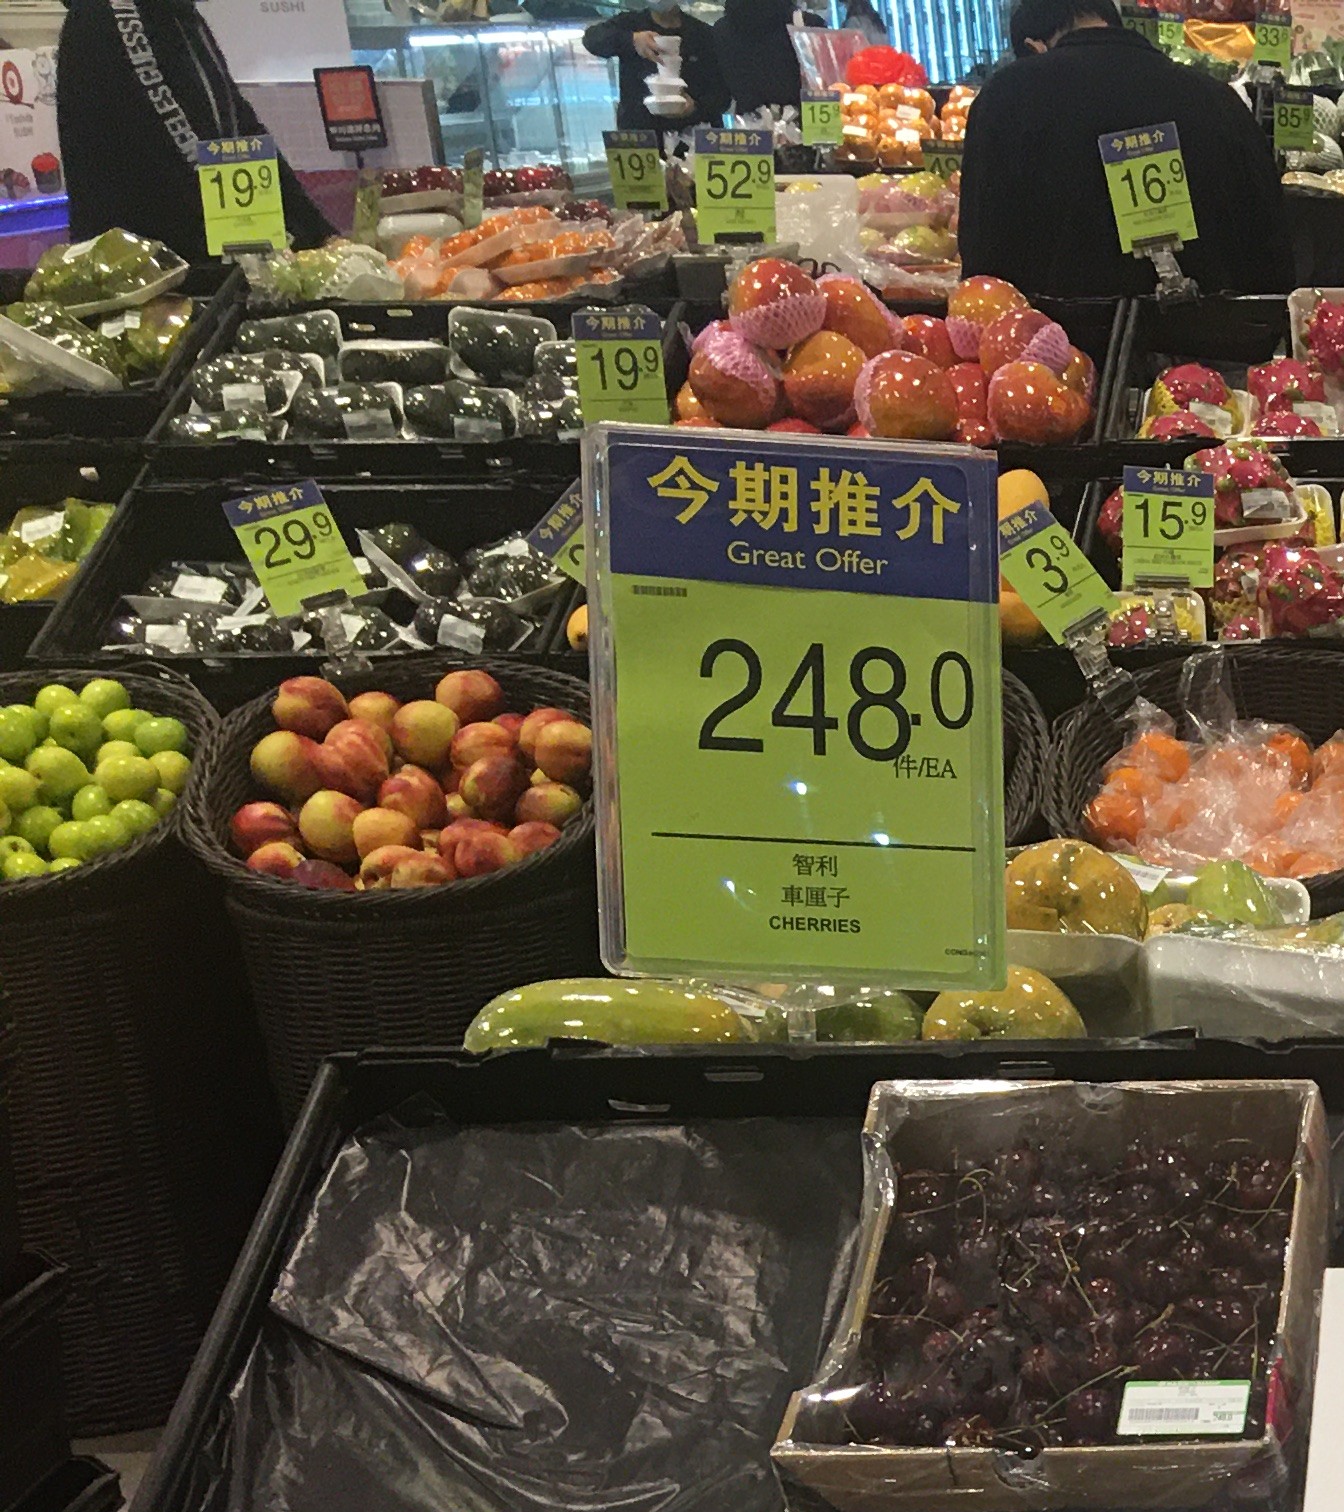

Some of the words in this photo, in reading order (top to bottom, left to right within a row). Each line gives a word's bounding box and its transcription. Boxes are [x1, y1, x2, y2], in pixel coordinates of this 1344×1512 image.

[259, 1, 306, 13] SUSHI
[206, 138, 263, 155] 今期推介
[210, 165, 273, 209] 19.9
[706, 158, 771, 201] 52.9
[1120, 158, 1184, 208] 16.9
[590, 347, 661, 392] 19.9
[1135, 469, 1203, 489] 今期推介
[237, 488, 304, 514] 今期推介
[647, 455, 961, 545] 今期推介
[1132, 500, 1208, 541] 15.9
[255, 513, 335, 569] 29.9
[726, 542, 805, 570] Great
[815, 546, 889, 577] Offer
[1025, 536, 1071, 594] 3.9
[698, 638, 974, 762] 248.0
[893, 756, 958, 780] 件/EA
[792, 852, 838, 879] 智利
[780, 885, 851, 909] 車厘子
[768, 914, 862, 935] CHERRIES
